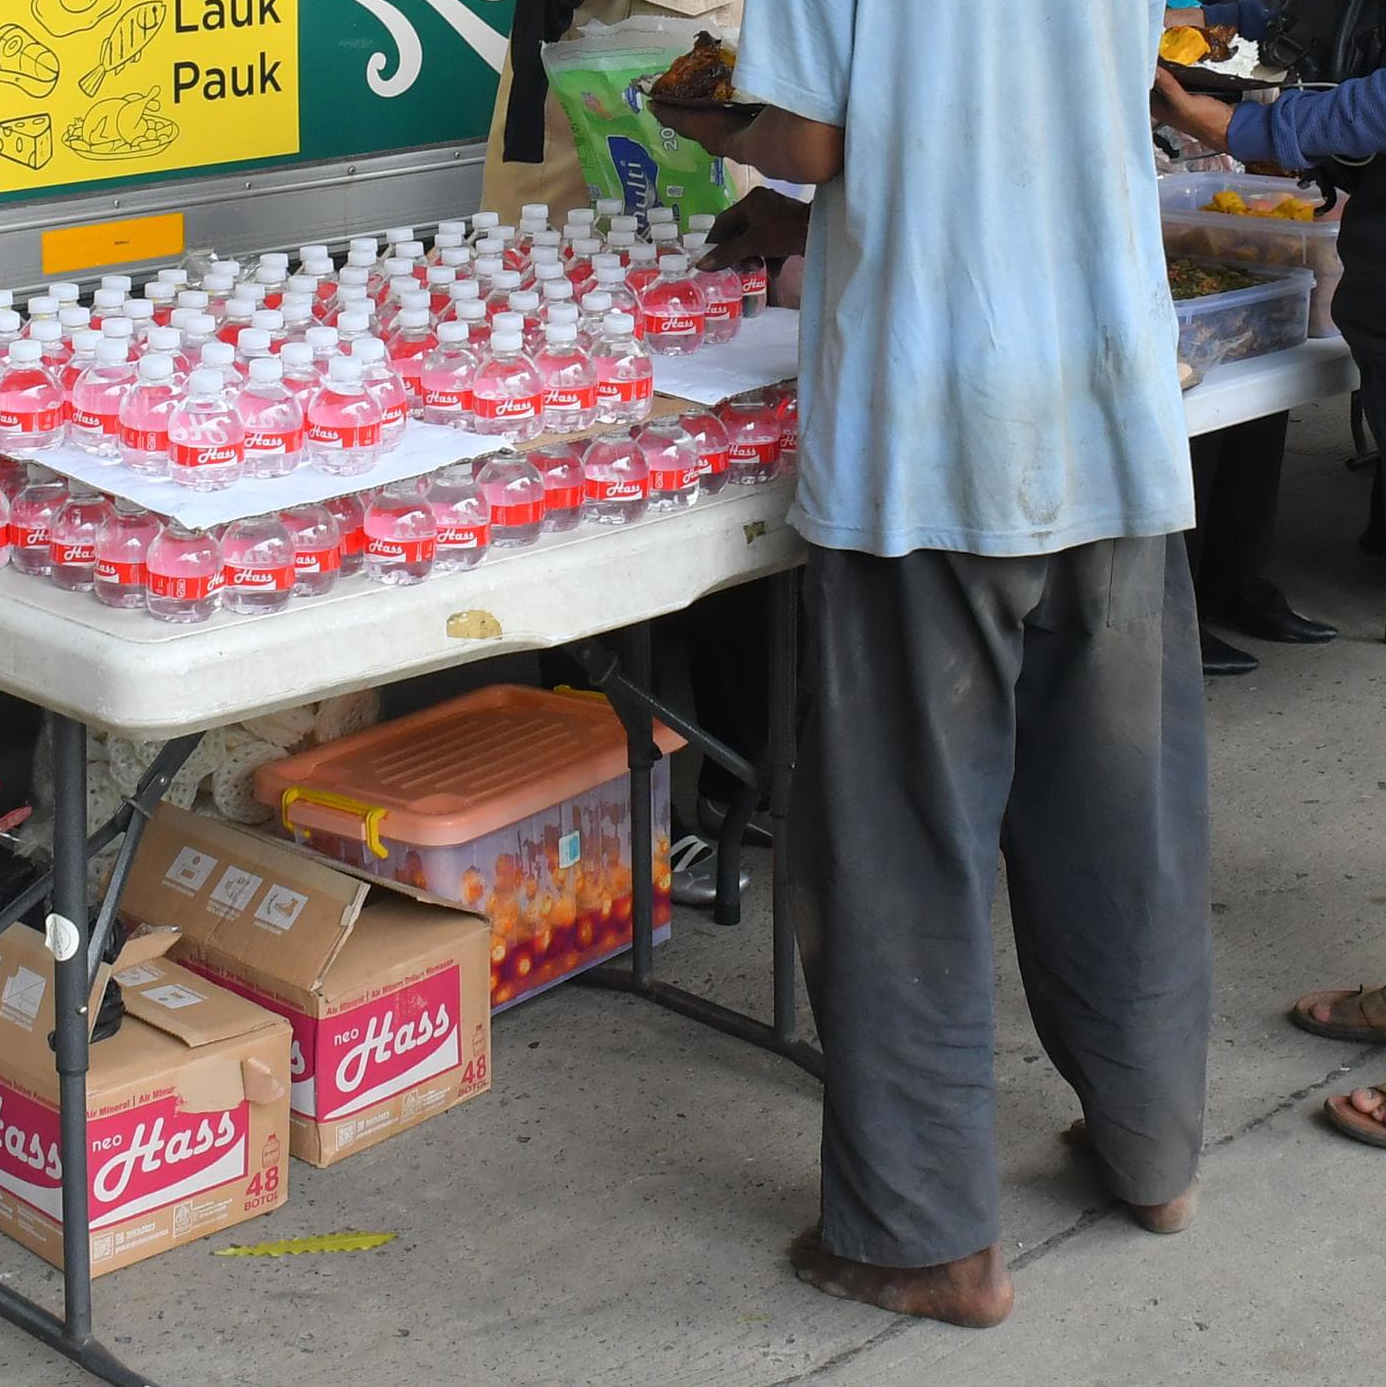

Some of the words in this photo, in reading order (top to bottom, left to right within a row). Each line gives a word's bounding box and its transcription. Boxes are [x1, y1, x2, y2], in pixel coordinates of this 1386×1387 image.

[172, 51, 283, 105] Pauk
[660, 126, 679, 152] 20
[661, 317, 695, 331] Hass
[426, 389, 459, 406] Hass
[495, 398, 532, 415] Hass
[244, 432, 284, 448] Hass
[197, 446, 237, 464] Hass
[605, 479, 641, 497] Hass
[437, 528, 476, 544] Hass
[368, 537, 404, 556] Hass
[295, 554, 317, 566] ass
[233, 568, 275, 584] Hass
[334, 1027, 360, 1047] neo
[335, 1002, 451, 1093] Hass
[461, 1053, 487, 1087] 48
[99, 1099, 131, 1117] Mineral
[138, 1092, 151, 1105] Air
[92, 1133, 123, 1154] neo
[93, 1111, 236, 1204] Hass
[245, 1165, 280, 1198] 48
[244, 1192, 279, 1212] BOTOL
